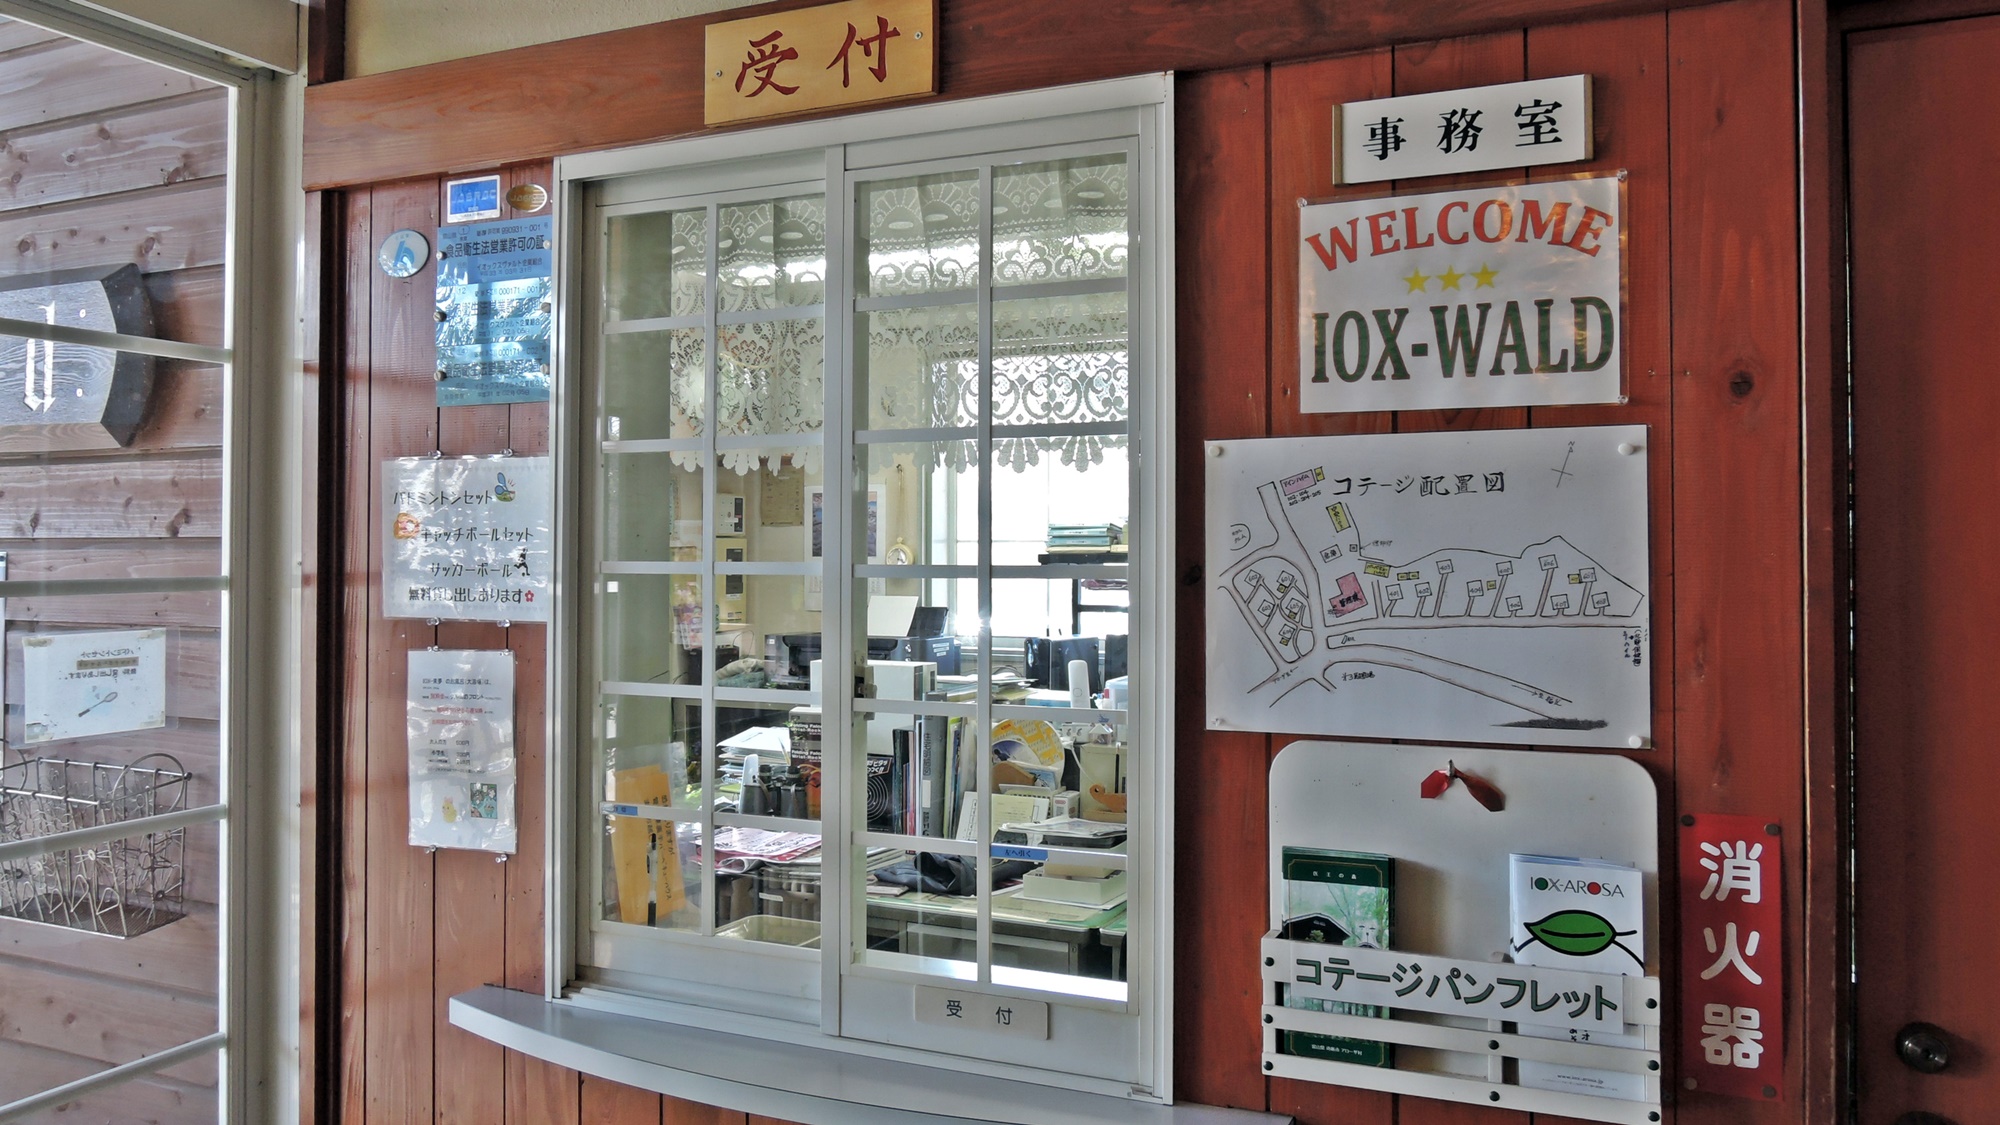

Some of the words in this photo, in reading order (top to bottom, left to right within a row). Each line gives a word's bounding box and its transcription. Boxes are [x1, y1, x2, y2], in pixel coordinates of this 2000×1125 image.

[734, 15, 901, 98] 受付
[1363, 98, 1563, 161] 事務室
[446, 235, 545, 259] 食品衛生法営業許可の証
[1305, 198, 1614, 273] WELCOME
[1311, 295, 1615, 384] IOX-WALD
[1332, 471, 1506, 497] コテージ配置図
[421, 526, 533, 542] キャッチボールセット
[430, 562, 512, 577] サッカーボール
[1530, 876, 1625, 898] IOX-AROSA
[1699, 839, 1764, 1069] 消火器
[1296, 956, 1618, 1021] コテージパンフレット
[946, 999, 1013, 1026] 受付
